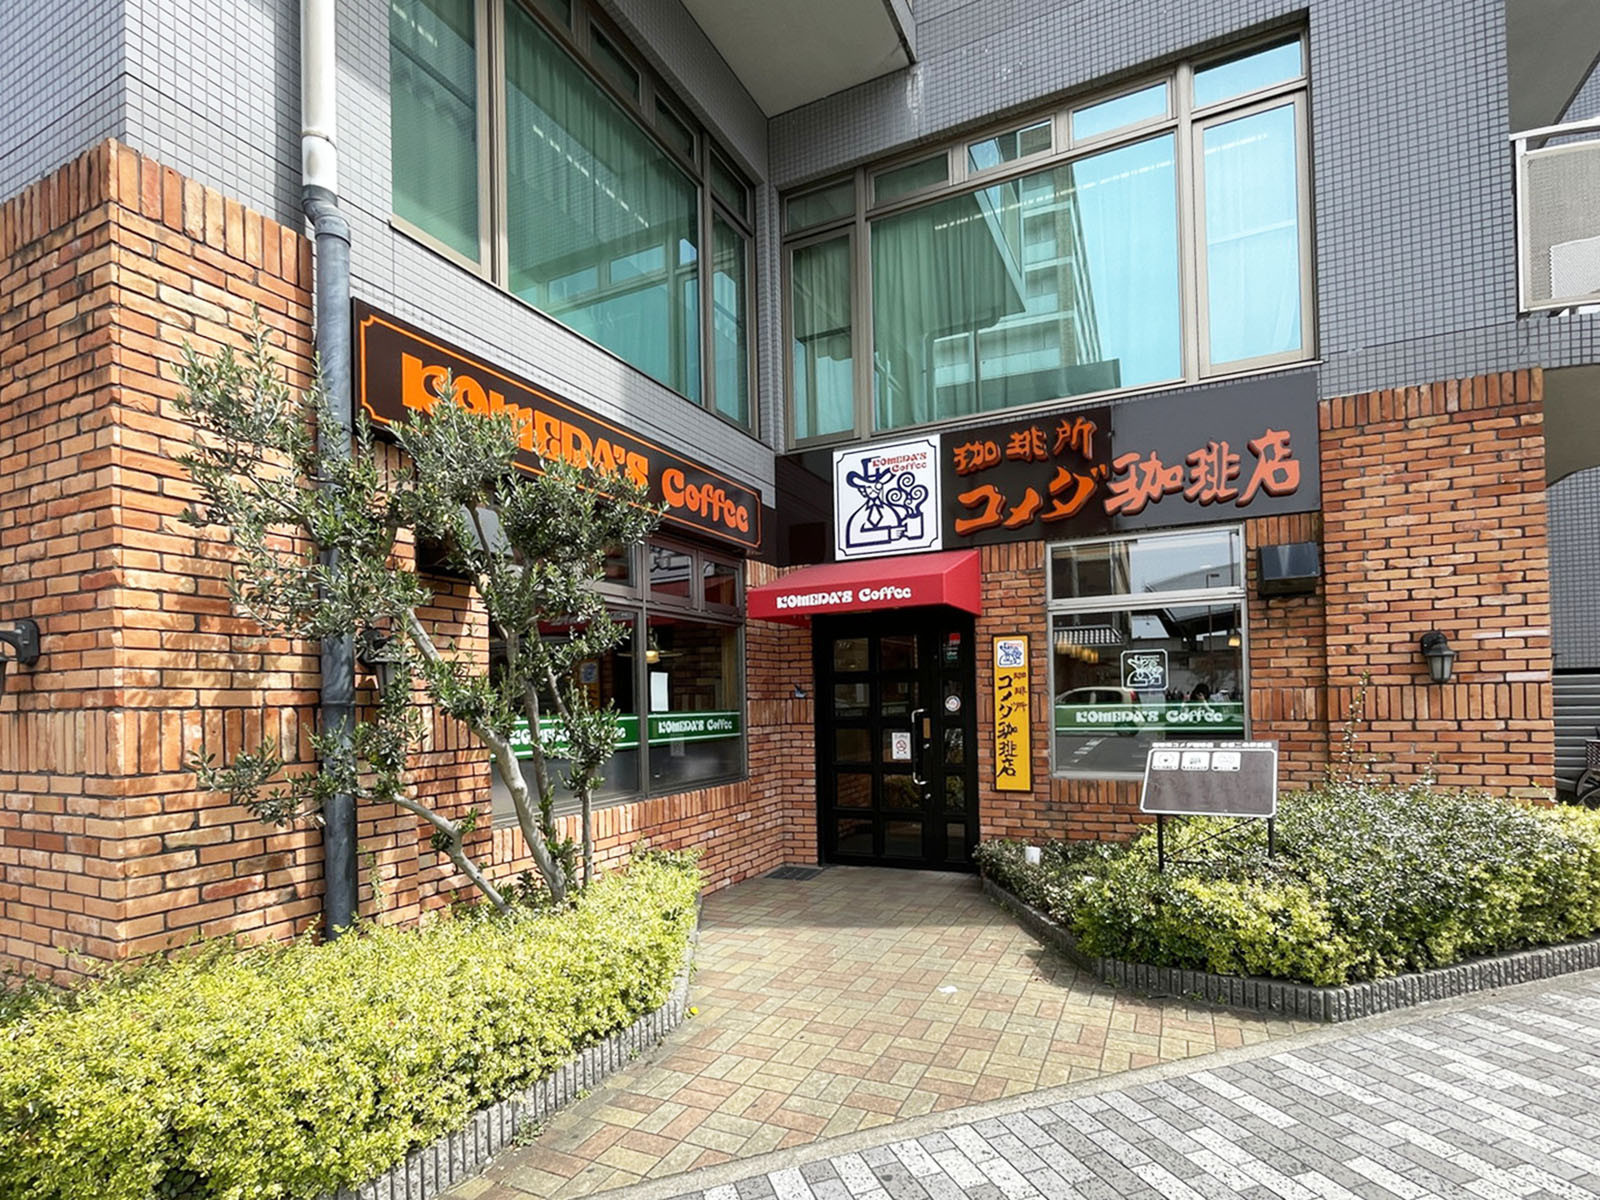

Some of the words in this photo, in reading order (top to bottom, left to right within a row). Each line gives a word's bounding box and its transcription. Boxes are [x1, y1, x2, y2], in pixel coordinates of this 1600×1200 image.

[953, 415, 1097, 475] 珈琲所
[872, 452, 927, 467] KOMEDA'S
[892, 461, 927, 472] Coffee
[662, 468, 749, 532] Coffee
[776, 590, 853, 609] KOMEDA'S
[858, 586, 912, 602] Coffee
[1076, 710, 1159, 723] KOMEDA'S
[1166, 708, 1224, 723] Coffee
[658, 720, 704, 734] KOMEDA'S
[706, 718, 733, 731] Coffee
